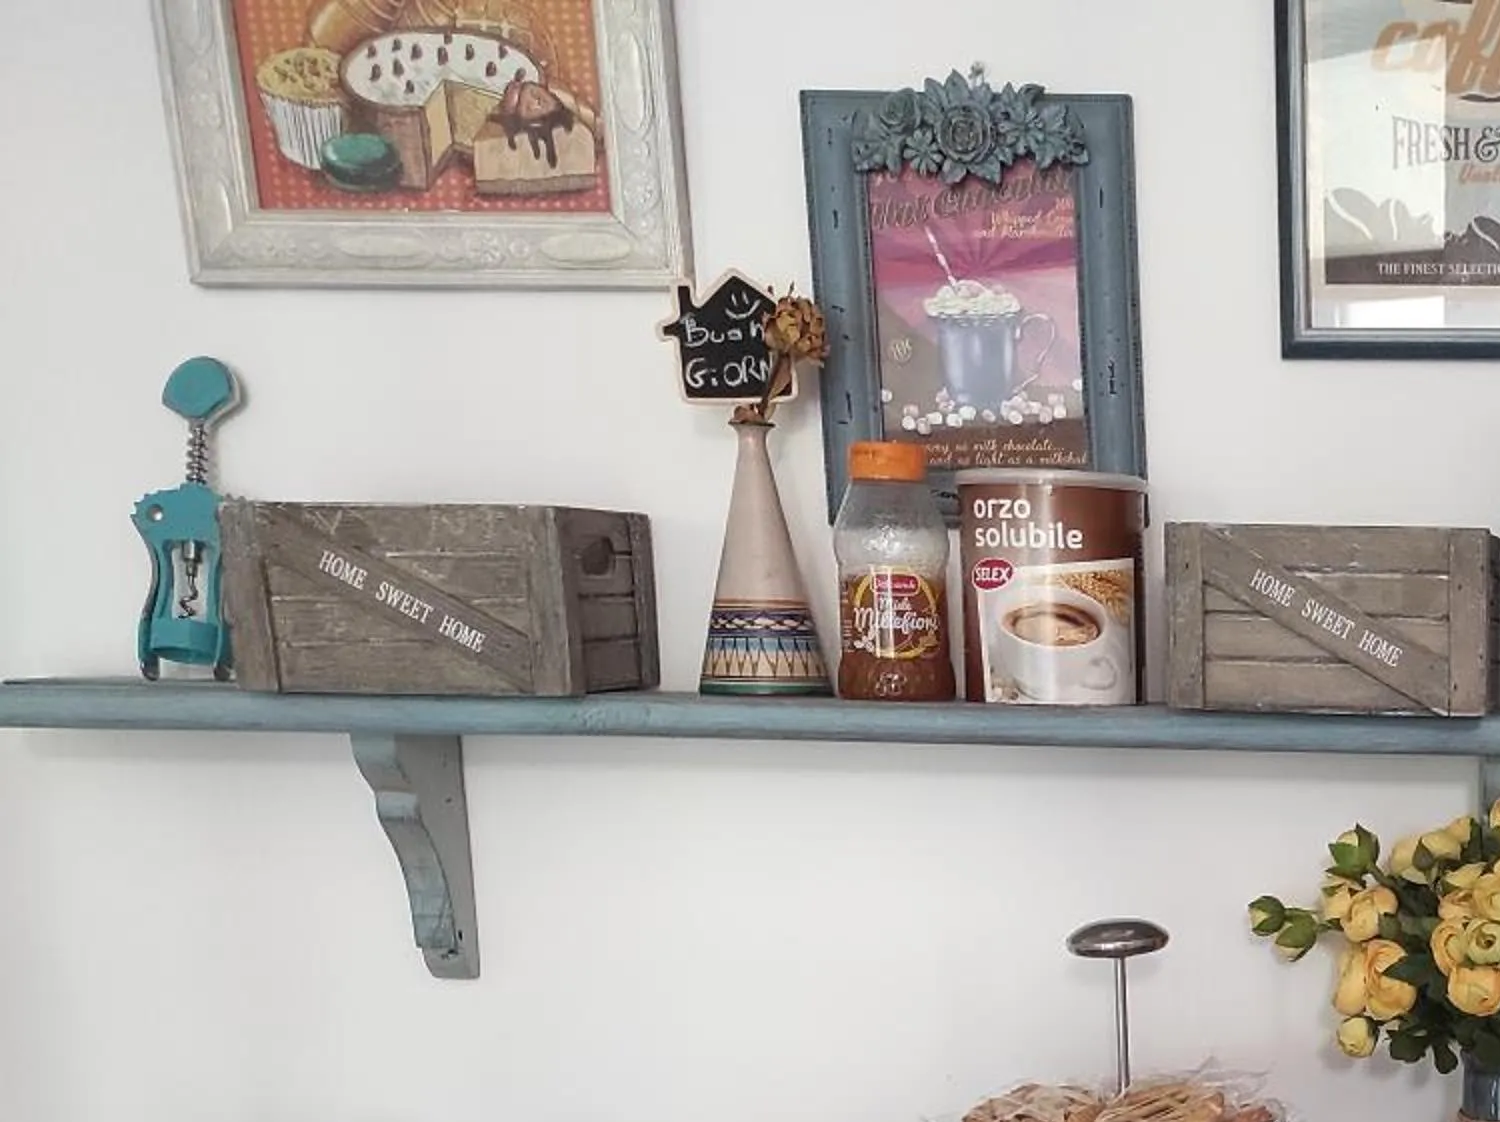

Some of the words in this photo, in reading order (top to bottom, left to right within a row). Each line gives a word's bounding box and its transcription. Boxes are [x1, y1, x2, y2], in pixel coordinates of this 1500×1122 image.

[1391, 115, 1471, 170] FRESH
[1378, 262, 1400, 276] THE
[1402, 262, 1444, 276] FINEST
[973, 498, 1031, 519] orzo
[975, 520, 1083, 549] solubile
[319, 548, 369, 591] HOME
[375, 580, 435, 626] SWEET
[438, 614, 488, 654] HOME
[1250, 568, 1296, 608] HOME
[1301, 598, 1355, 640] SWEET
[1359, 629, 1404, 668] HOME
